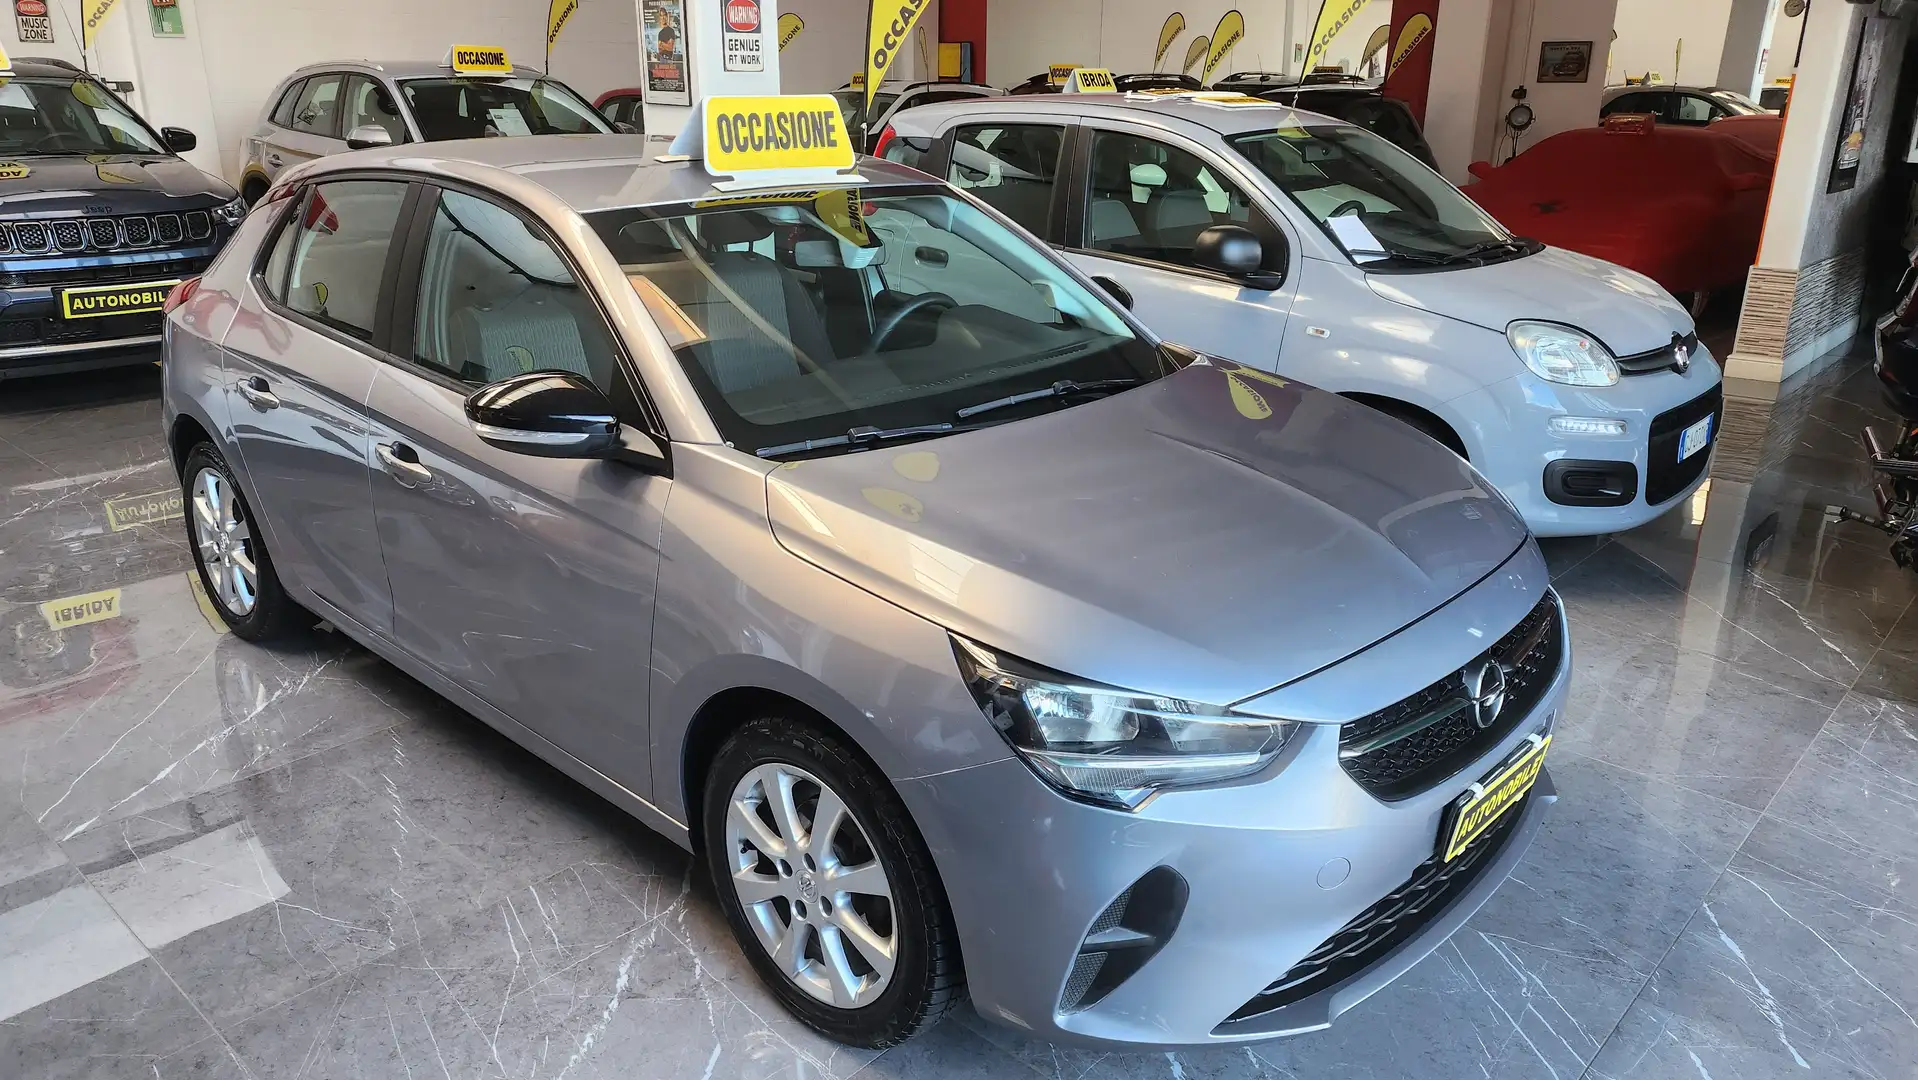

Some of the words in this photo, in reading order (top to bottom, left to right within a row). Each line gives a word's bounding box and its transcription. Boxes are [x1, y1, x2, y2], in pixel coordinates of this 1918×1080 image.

[549, 1, 575, 43] OCCASIONE
[728, 5, 759, 24] WARNING
[21, 17, 48, 29] MUSIC
[23, 29, 48, 40] ZONE
[728, 38, 760, 52] GENIUS
[1206, 30, 1241, 73] OCCASIONE
[1391, 25, 1429, 70] OCCASIONE
[457, 51, 505, 66] OCCASIONE
[728, 54, 738, 65] AT
[740, 54, 761, 65] WORK
[1079, 72, 1113, 88] IBRIDA
[717, 110, 837, 153] OCCASIONE
[82, 205, 113, 215] Jeep
